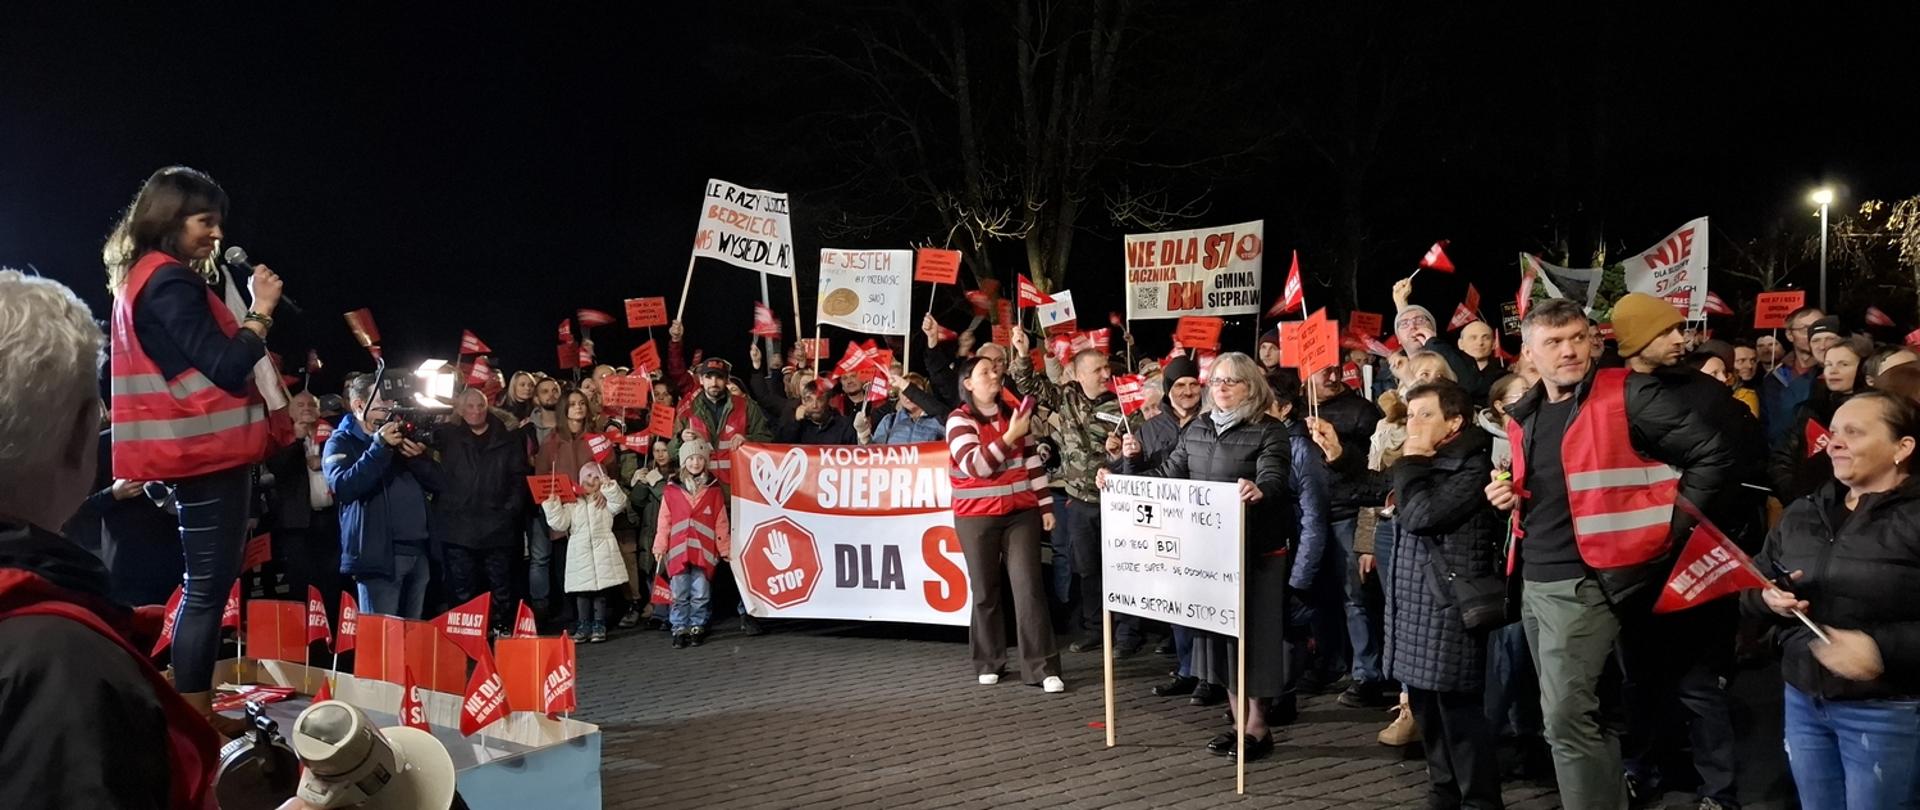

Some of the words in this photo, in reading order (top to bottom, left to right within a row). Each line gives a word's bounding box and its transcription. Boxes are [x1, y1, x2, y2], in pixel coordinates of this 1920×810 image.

[725, 186, 761, 211] RAZY
[1160, 237, 1198, 266] DLA
[1202, 232, 1235, 270] S7
[1643, 227, 1695, 270] NIE
[841, 252, 891, 271] JESTEM
[1214, 271, 1255, 289] GMINA
[1167, 280, 1204, 311] BDI
[1207, 289, 1260, 308] SIEPRAW
[820, 446, 918, 465] KOCHAM
[1157, 483, 1181, 502] NOWY
[1189, 485, 1211, 505] PIEC
[1136, 504, 1153, 524] S7
[1114, 538, 1126, 548] DO
[1156, 540, 1177, 554] BDI
[834, 543, 906, 590] DLA
[767, 568, 805, 595] STOP
[1108, 592, 1137, 607] GMINA
[1140, 597, 1182, 614] SIEPRAW
[1186, 604, 1216, 621] STOP
[1220, 609, 1236, 628] S7
[548, 665, 571, 688] DLA
[465, 692, 487, 717] NIE
